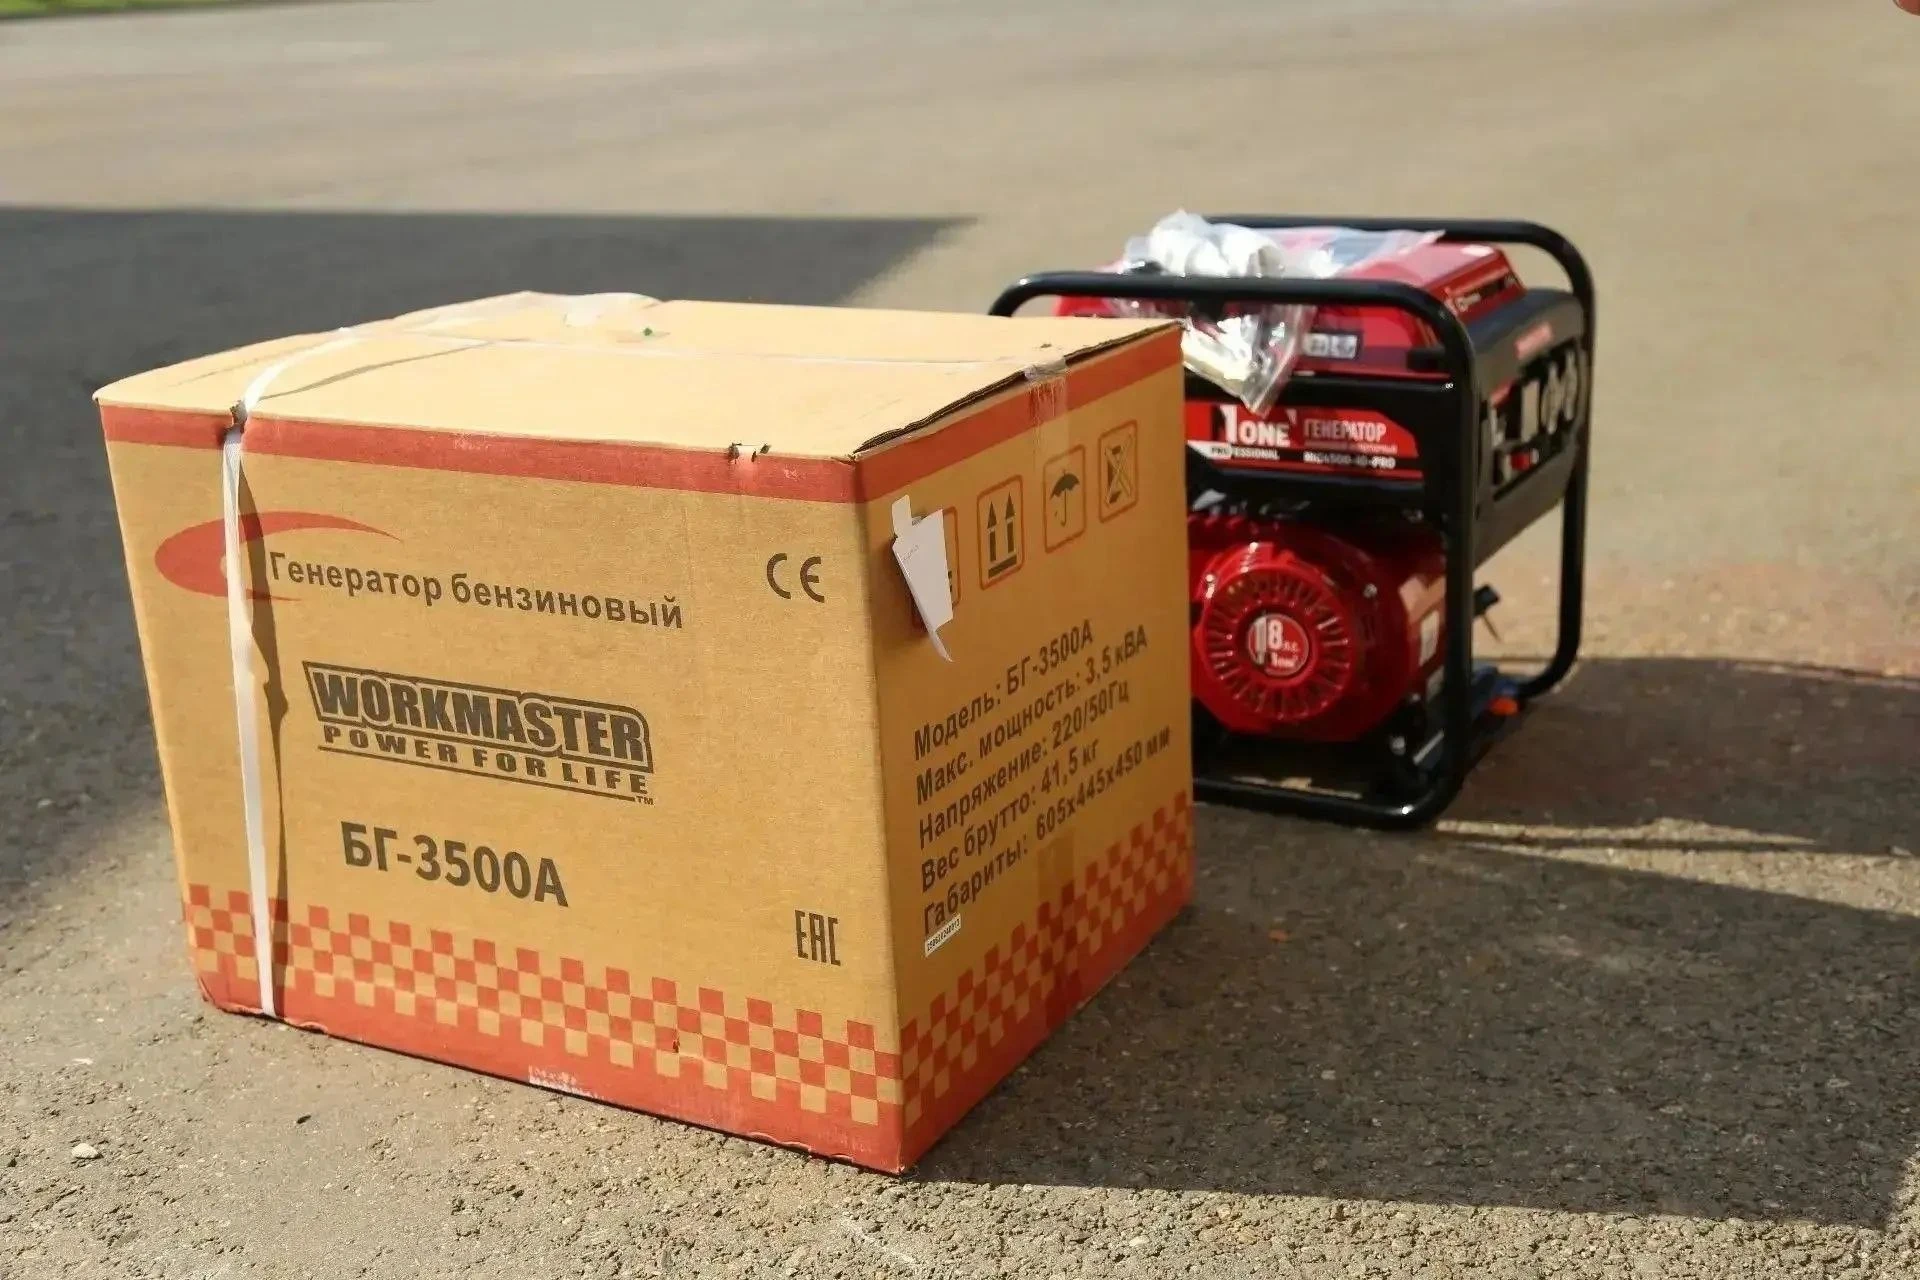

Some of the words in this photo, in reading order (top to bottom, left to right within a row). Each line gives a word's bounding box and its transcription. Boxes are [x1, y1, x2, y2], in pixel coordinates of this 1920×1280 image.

[1304, 418, 1387, 443] ГЕНЕРАТОР
[270, 551, 442, 607] Генератор
[451, 573, 683, 629] бензиновый
[312, 671, 645, 763] WORKMASTER
[914, 683, 1001, 761] Модель:
[1006, 619, 1093, 695] БГ-3500А
[916, 751, 974, 806] Макс.
[979, 671, 1081, 759] мощность:
[1115, 624, 1148, 666] кВА
[323, 724, 458, 764] POWER
[472, 747, 547, 778] FOR
[561, 762, 648, 795] LIFE
[919, 736, 1048, 850] Напряжение:
[1052, 680, 1130, 750] 220/50Гц
[922, 846, 960, 893] Вес
[964, 785, 1037, 857] брутто:
[1041, 747, 1079, 794] 41,5
[1083, 738, 1099, 767] кг
[340, 821, 569, 908] БГ-3500А
[924, 833, 1029, 935] Габариты:
[1146, 725, 1171, 758] мм
